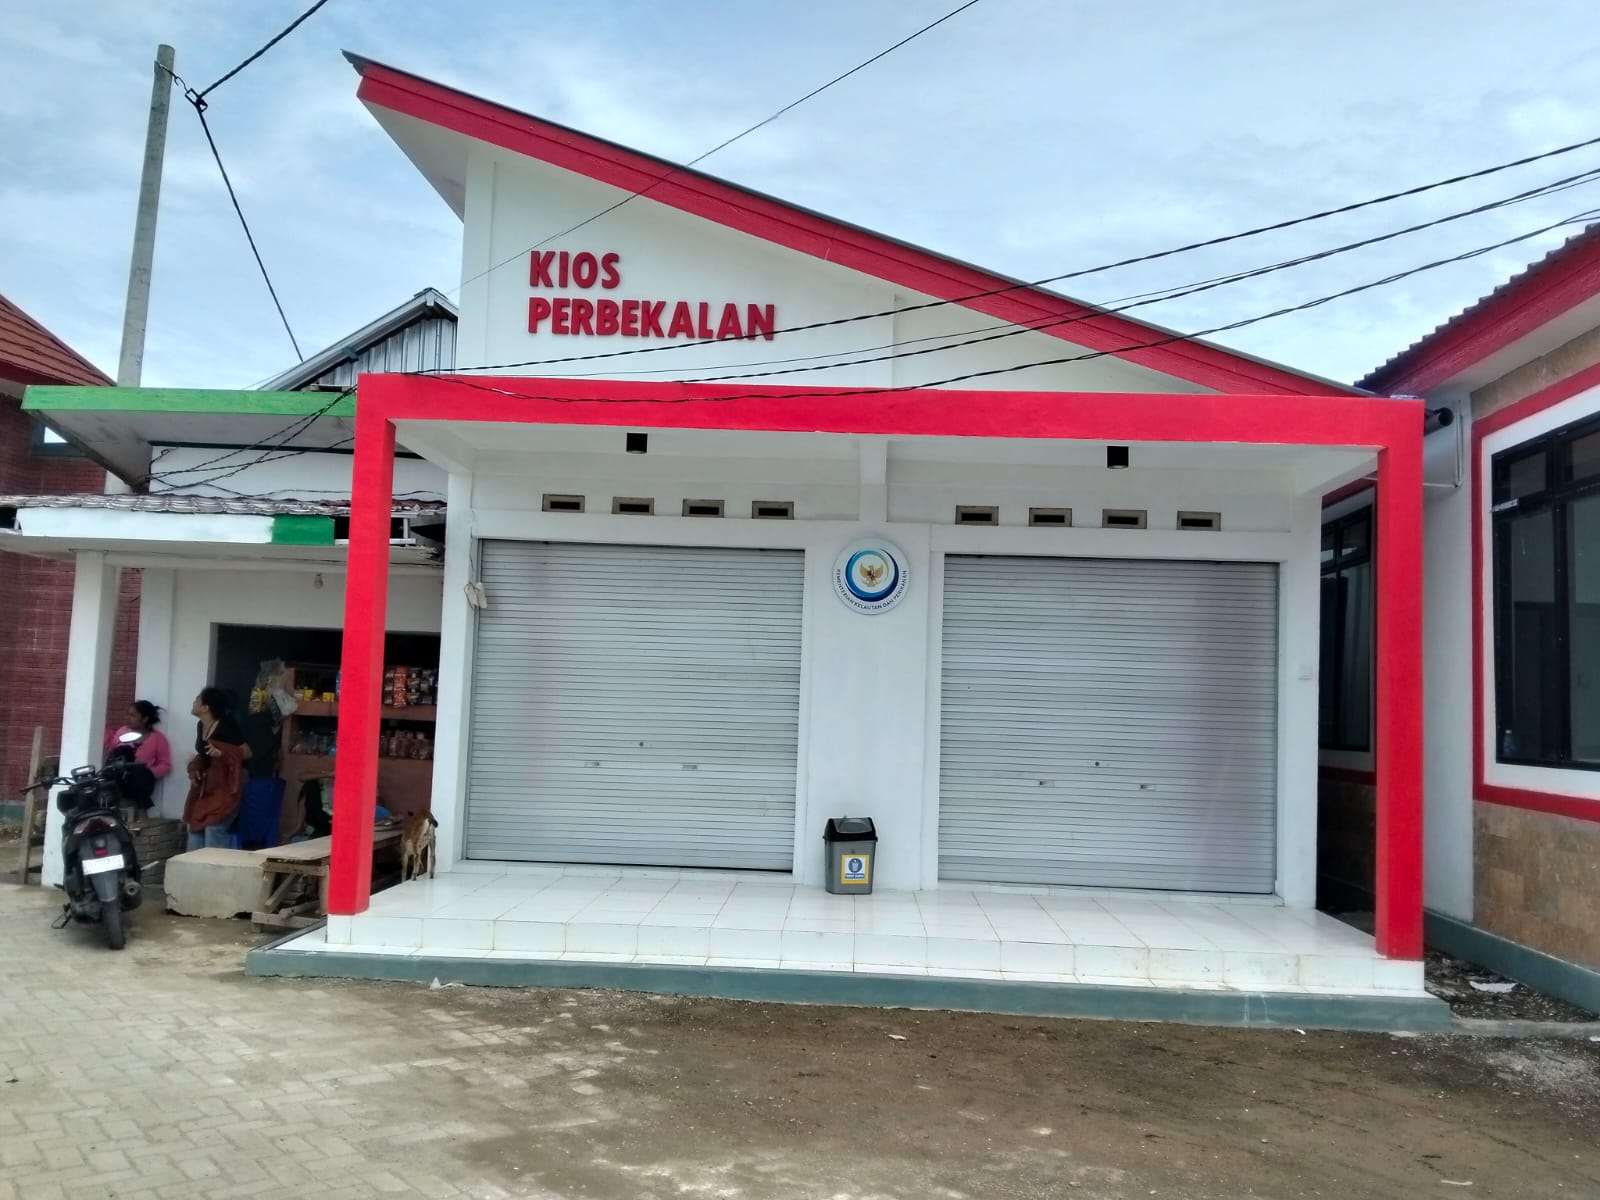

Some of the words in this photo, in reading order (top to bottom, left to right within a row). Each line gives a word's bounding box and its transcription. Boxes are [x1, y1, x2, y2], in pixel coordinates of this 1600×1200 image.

[529, 250, 620, 289] KIOS
[528, 297, 775, 340] PERBEKALAN
[854, 602, 882, 610] KELAUTAN
[883, 599, 894, 608] DAN
[894, 570, 908, 601] PERIKANAN
